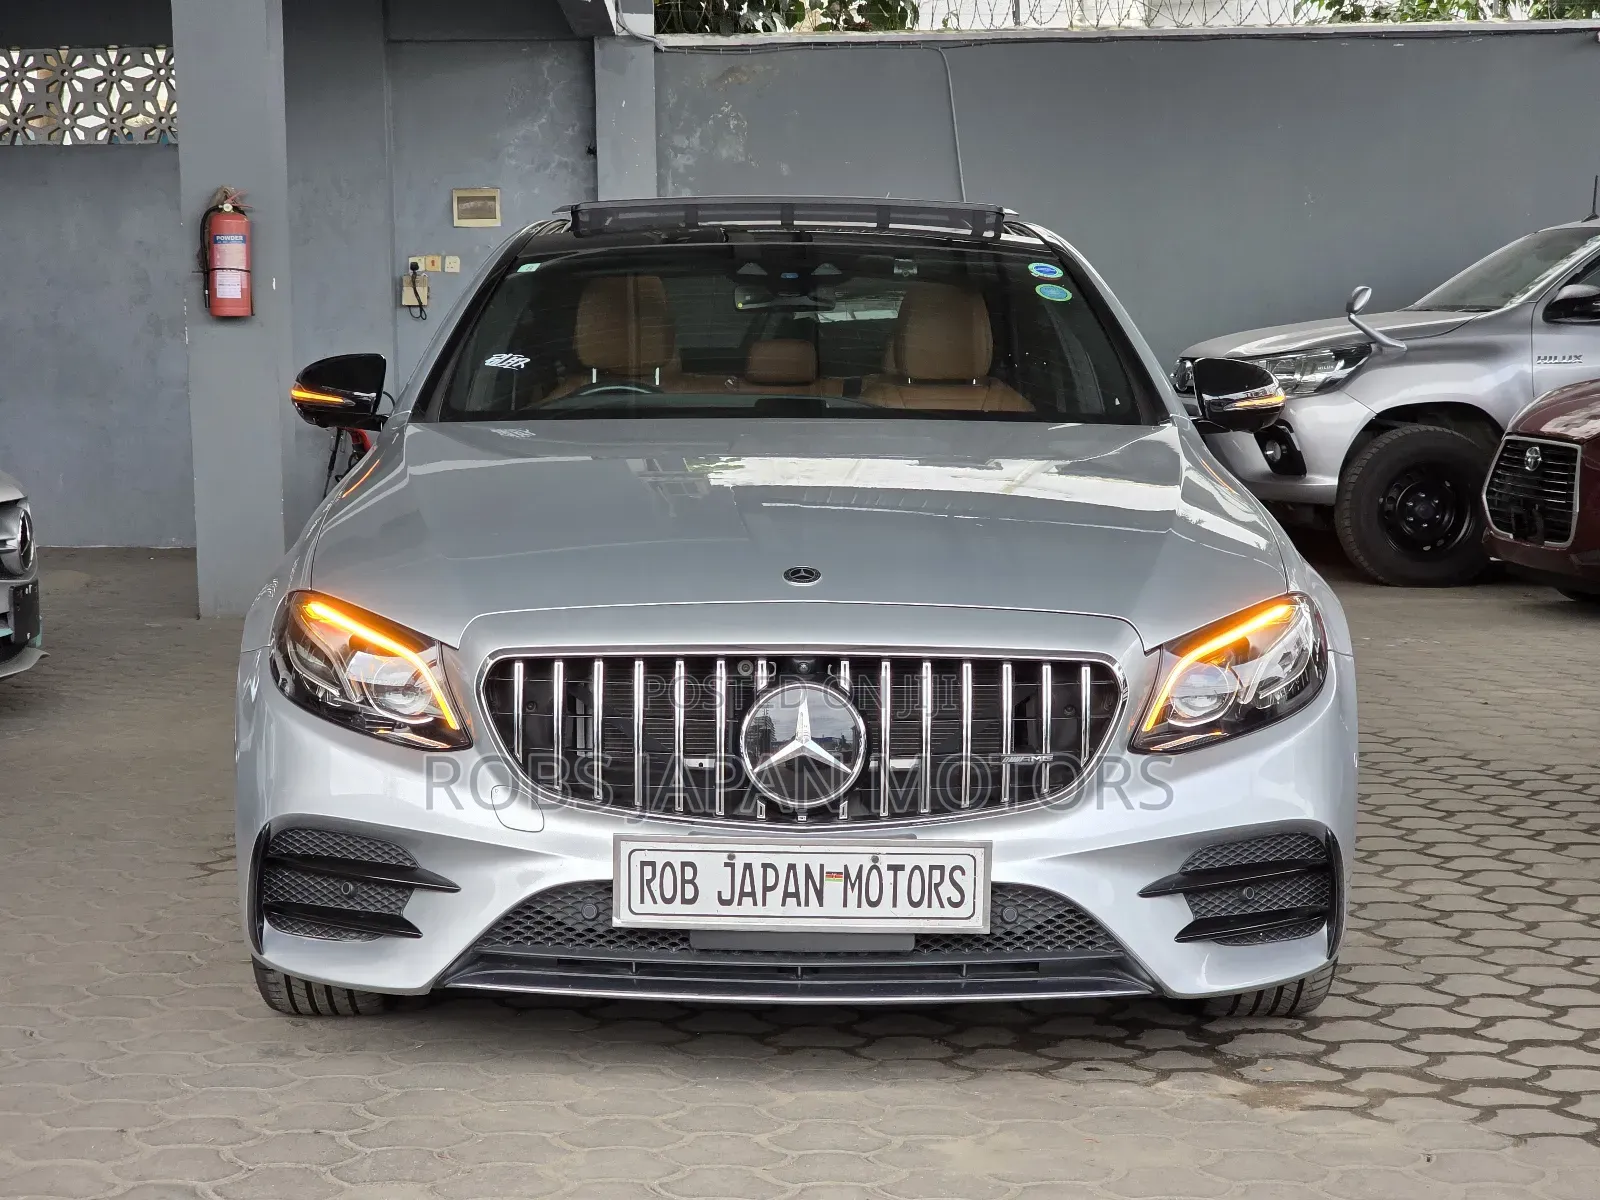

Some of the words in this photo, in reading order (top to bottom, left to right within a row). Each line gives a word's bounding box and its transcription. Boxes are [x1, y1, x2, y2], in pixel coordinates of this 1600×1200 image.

[1536, 354, 1583, 365] HILUX
[639, 860, 700, 906] ROB
[717, 861, 825, 908] JAPAN
[842, 862, 967, 909] MOTORS
